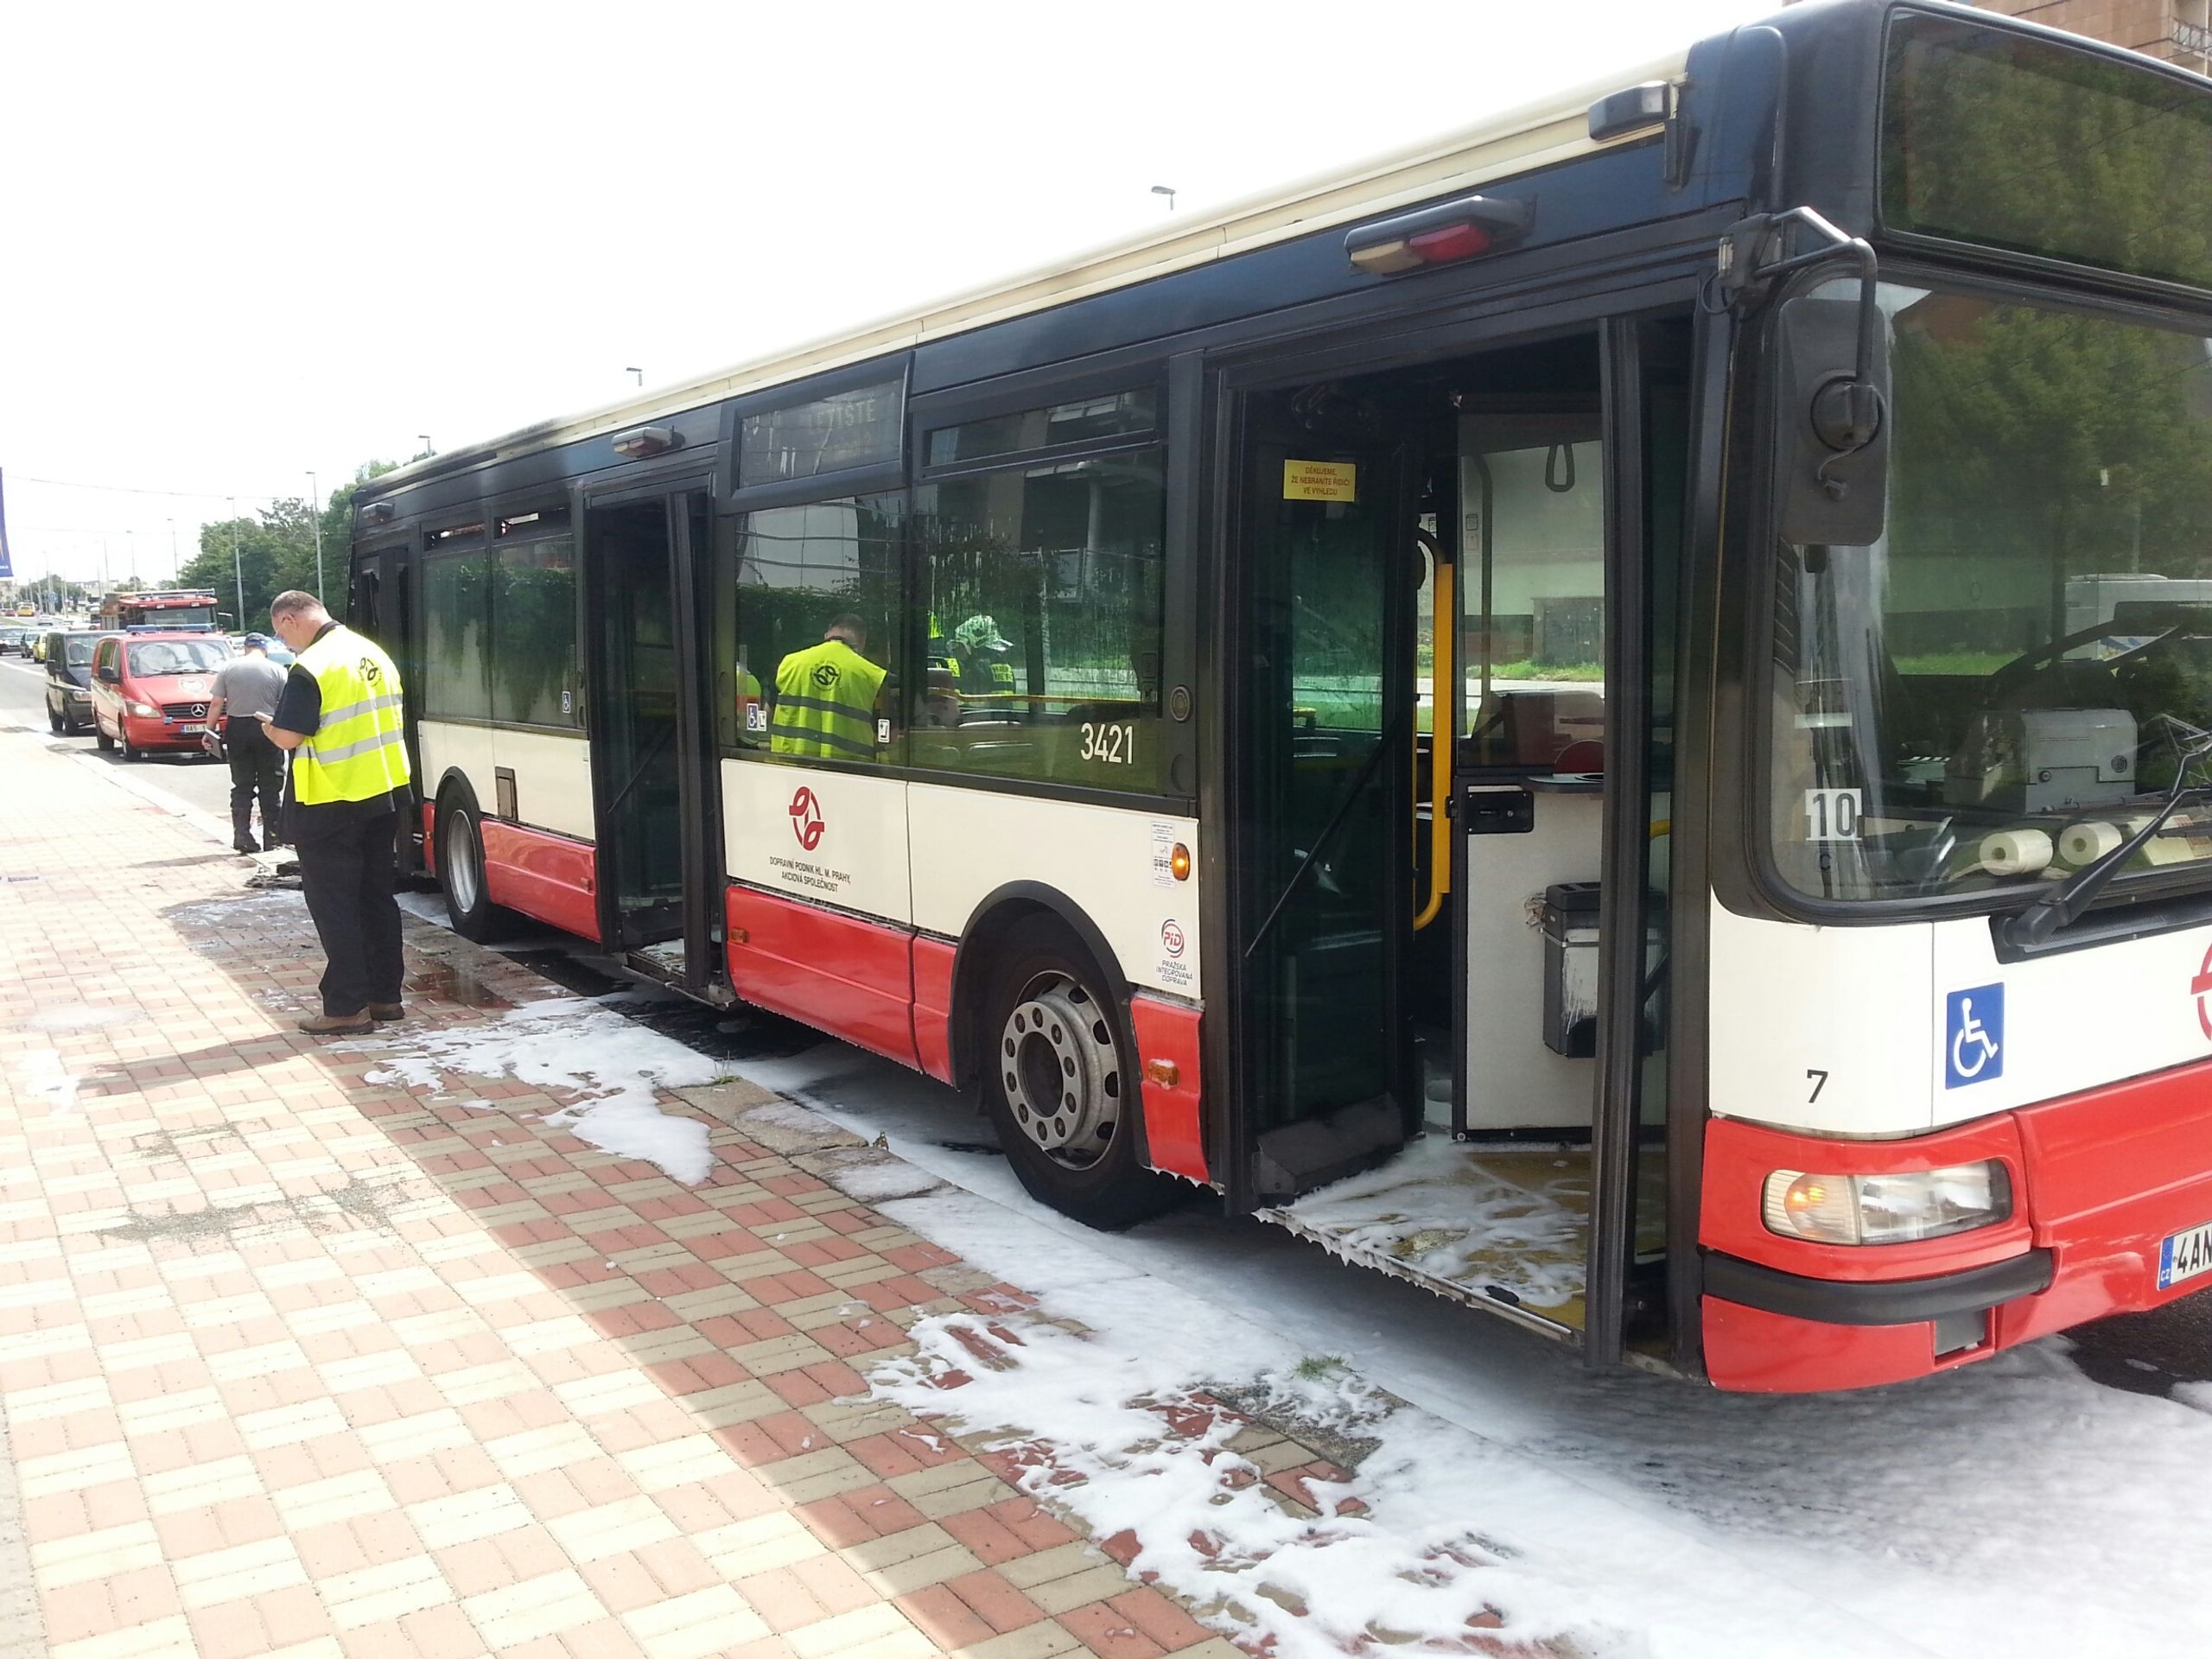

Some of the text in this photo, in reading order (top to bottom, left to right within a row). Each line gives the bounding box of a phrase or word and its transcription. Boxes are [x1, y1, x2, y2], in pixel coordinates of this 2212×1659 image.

[1081, 722, 1133, 764] 3421
[1813, 792, 1855, 836] 10
[769, 856, 794, 868] DOPRAVNÍ
[795, 861, 814, 874] PODNIK
[781, 871, 838, 892] AKCIOVÁ SPOLEČNOST
[1161, 975, 1187, 986] DOPRAVA
[1807, 1069, 1828, 1103] 7
[2160, 1268, 2171, 1281] CZ
